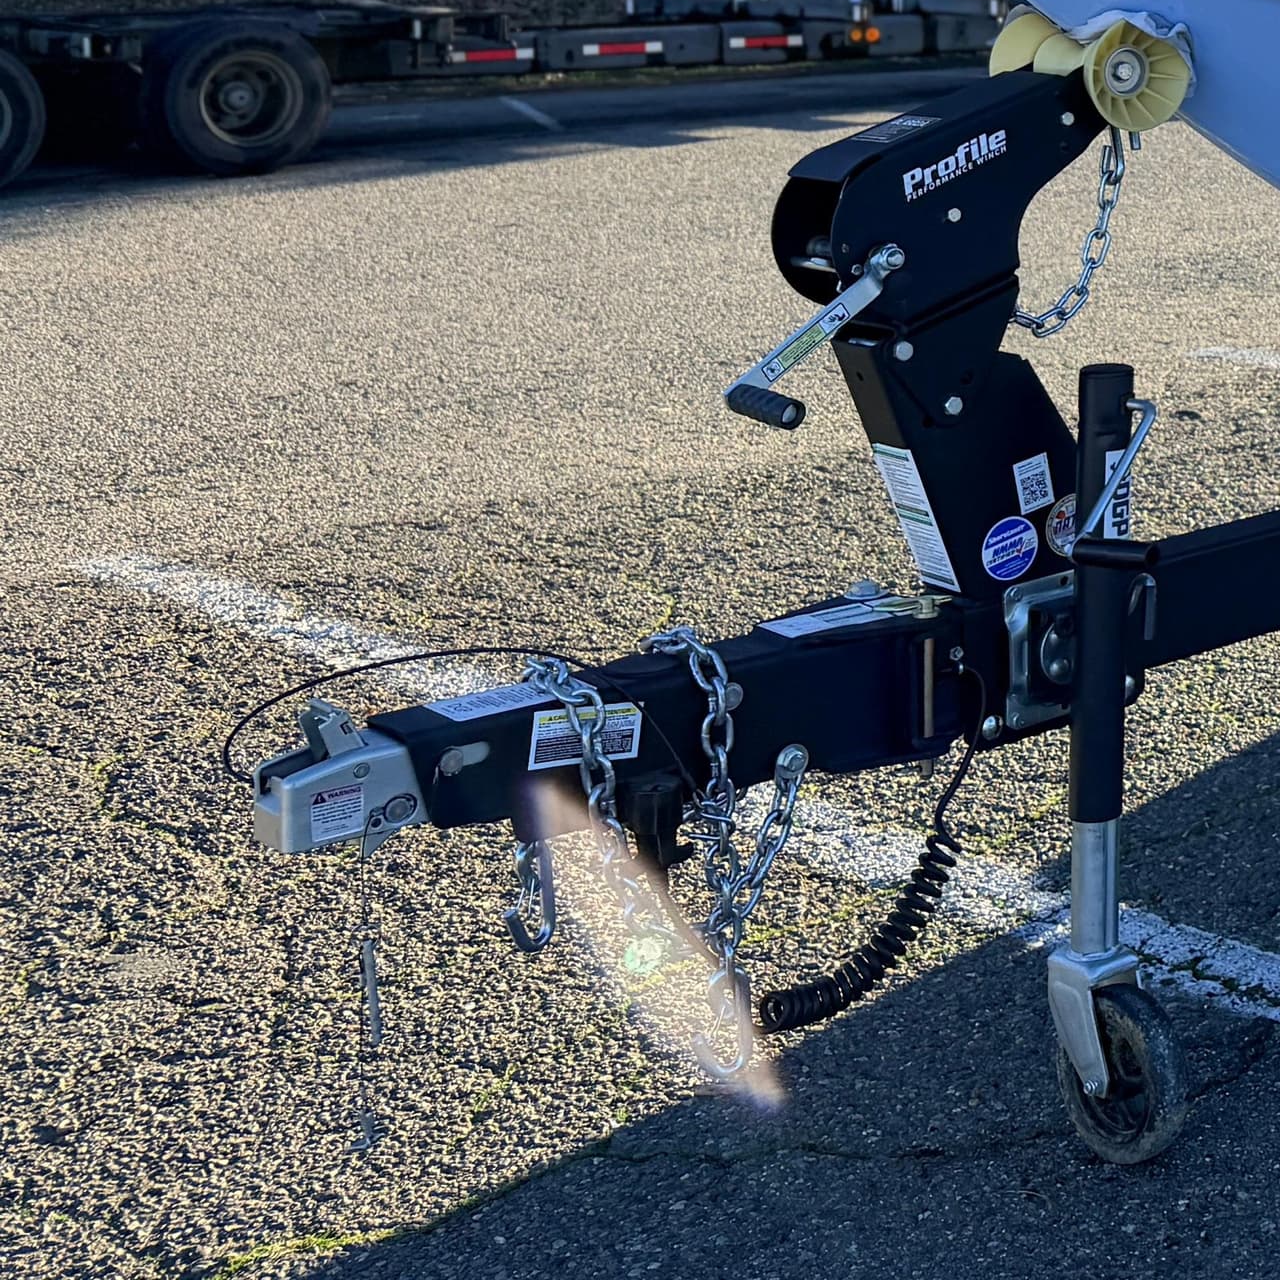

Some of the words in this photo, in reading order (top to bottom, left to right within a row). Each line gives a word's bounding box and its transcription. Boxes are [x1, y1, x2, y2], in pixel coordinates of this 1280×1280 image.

[902, 129, 1007, 196] Profile
[906, 161, 974, 202] PERFORMANCE
[976, 144, 1007, 166] WINCH
